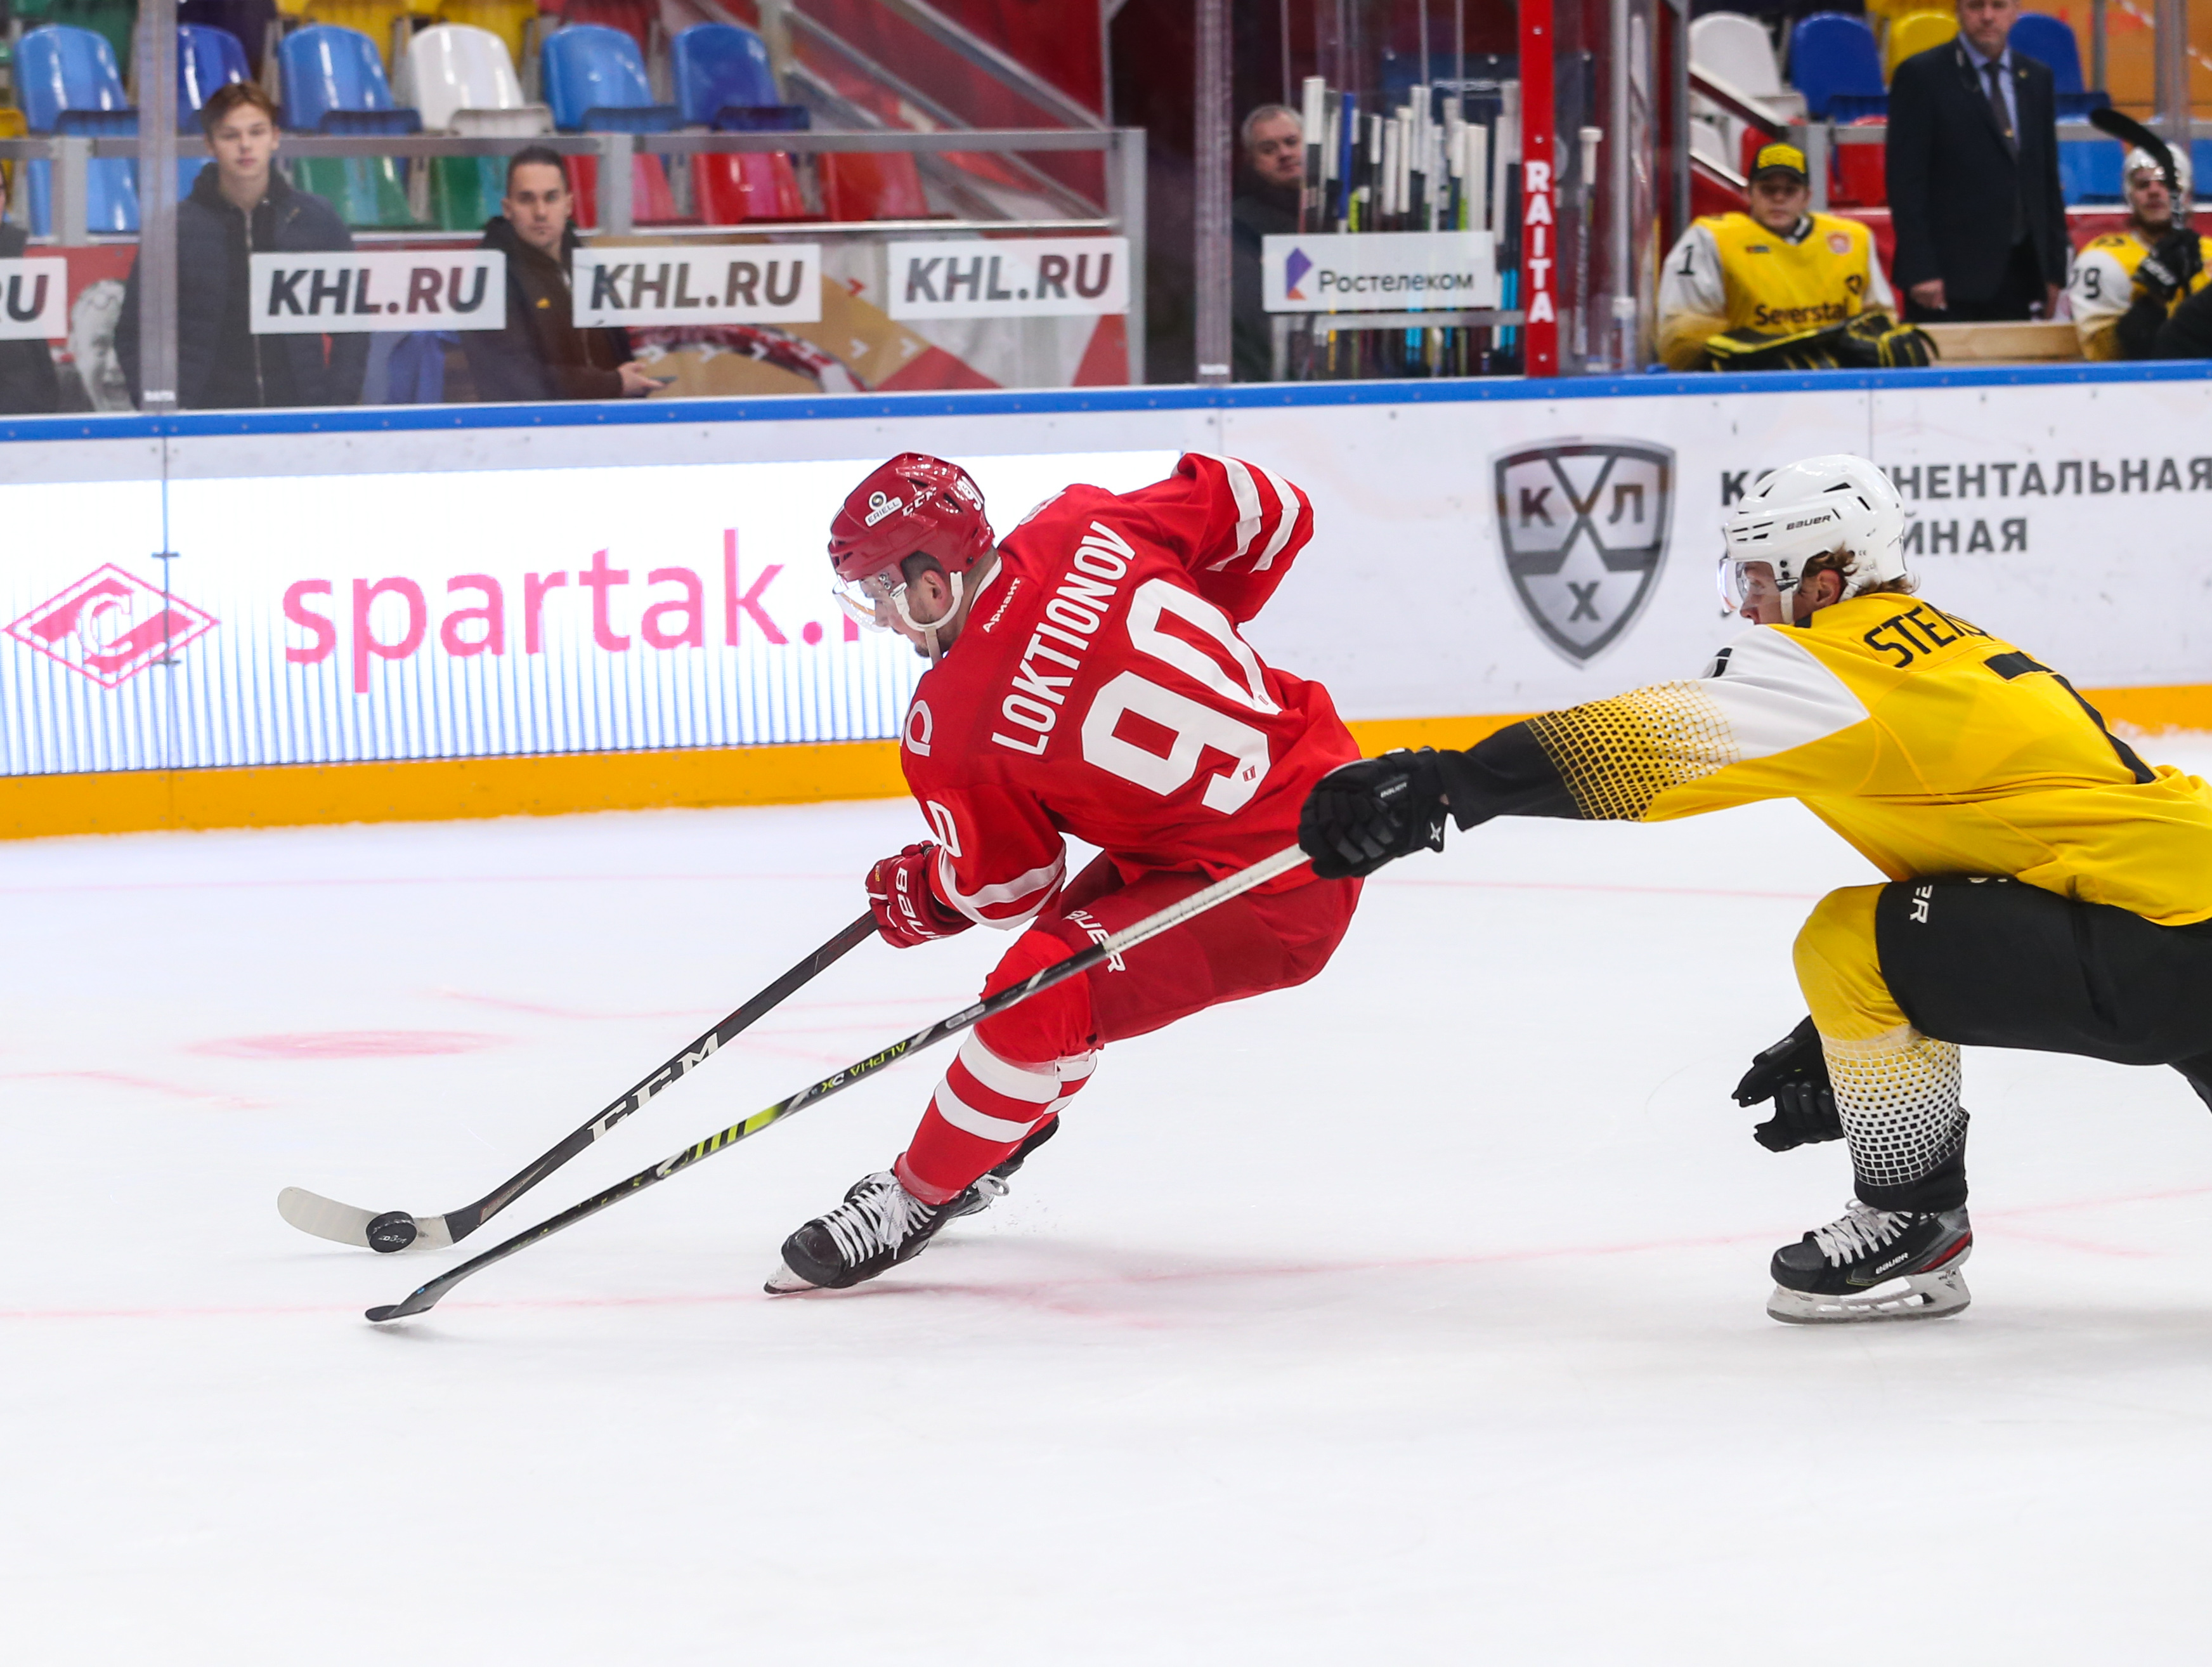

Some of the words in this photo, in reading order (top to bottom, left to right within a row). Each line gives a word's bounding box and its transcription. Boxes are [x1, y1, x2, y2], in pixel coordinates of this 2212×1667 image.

[1525, 161, 1555, 324] RAITA
[1677, 244, 1695, 275] 1
[0, 274, 49, 322] U
[268, 266, 488, 317] KHL.RU
[590, 260, 803, 311] KHL.RU
[904, 253, 1112, 303] KHL.RU
[1318, 270, 1474, 293] Ростелеком
[1755, 297, 1849, 326] Severstal
[1721, 457, 2212, 507] КНЕНТАЛЬНАЯ
[867, 500, 901, 524] ERIELL
[1786, 514, 1831, 531] BAUER
[282, 527, 859, 693] spartak.
[982, 577, 1021, 633] Ариант
[991, 521, 1135, 755] LOKTIONOV
[1081, 578, 1283, 815] 90
[850, 1042, 906, 1076] ALPHA
[587, 1032, 719, 1141] CCM
[1875, 1252, 1908, 1274] BAUER
